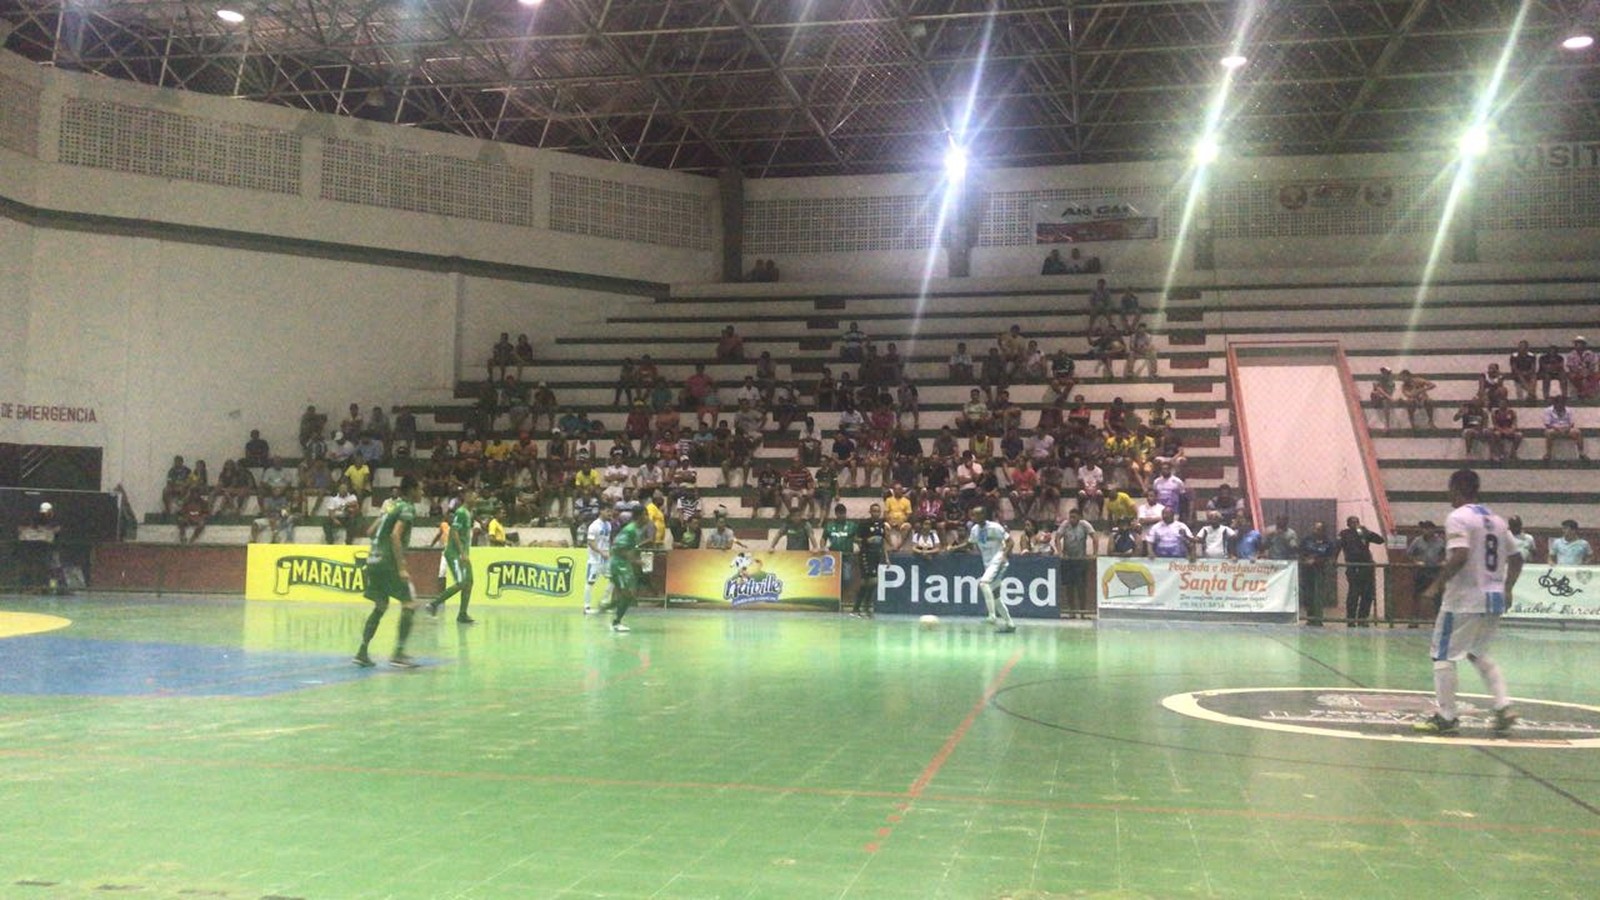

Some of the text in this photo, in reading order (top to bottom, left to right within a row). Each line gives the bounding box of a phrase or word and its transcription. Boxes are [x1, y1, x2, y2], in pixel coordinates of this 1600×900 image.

[1, 402, 13, 419] DE
[1485, 533, 1498, 572] 8
[292, 559, 368, 591] MARATÁ
[502, 564, 570, 592] MARATÁ
[1168, 561, 1209, 572] Pousada
[1179, 572, 1266, 594] Santa Cruz
